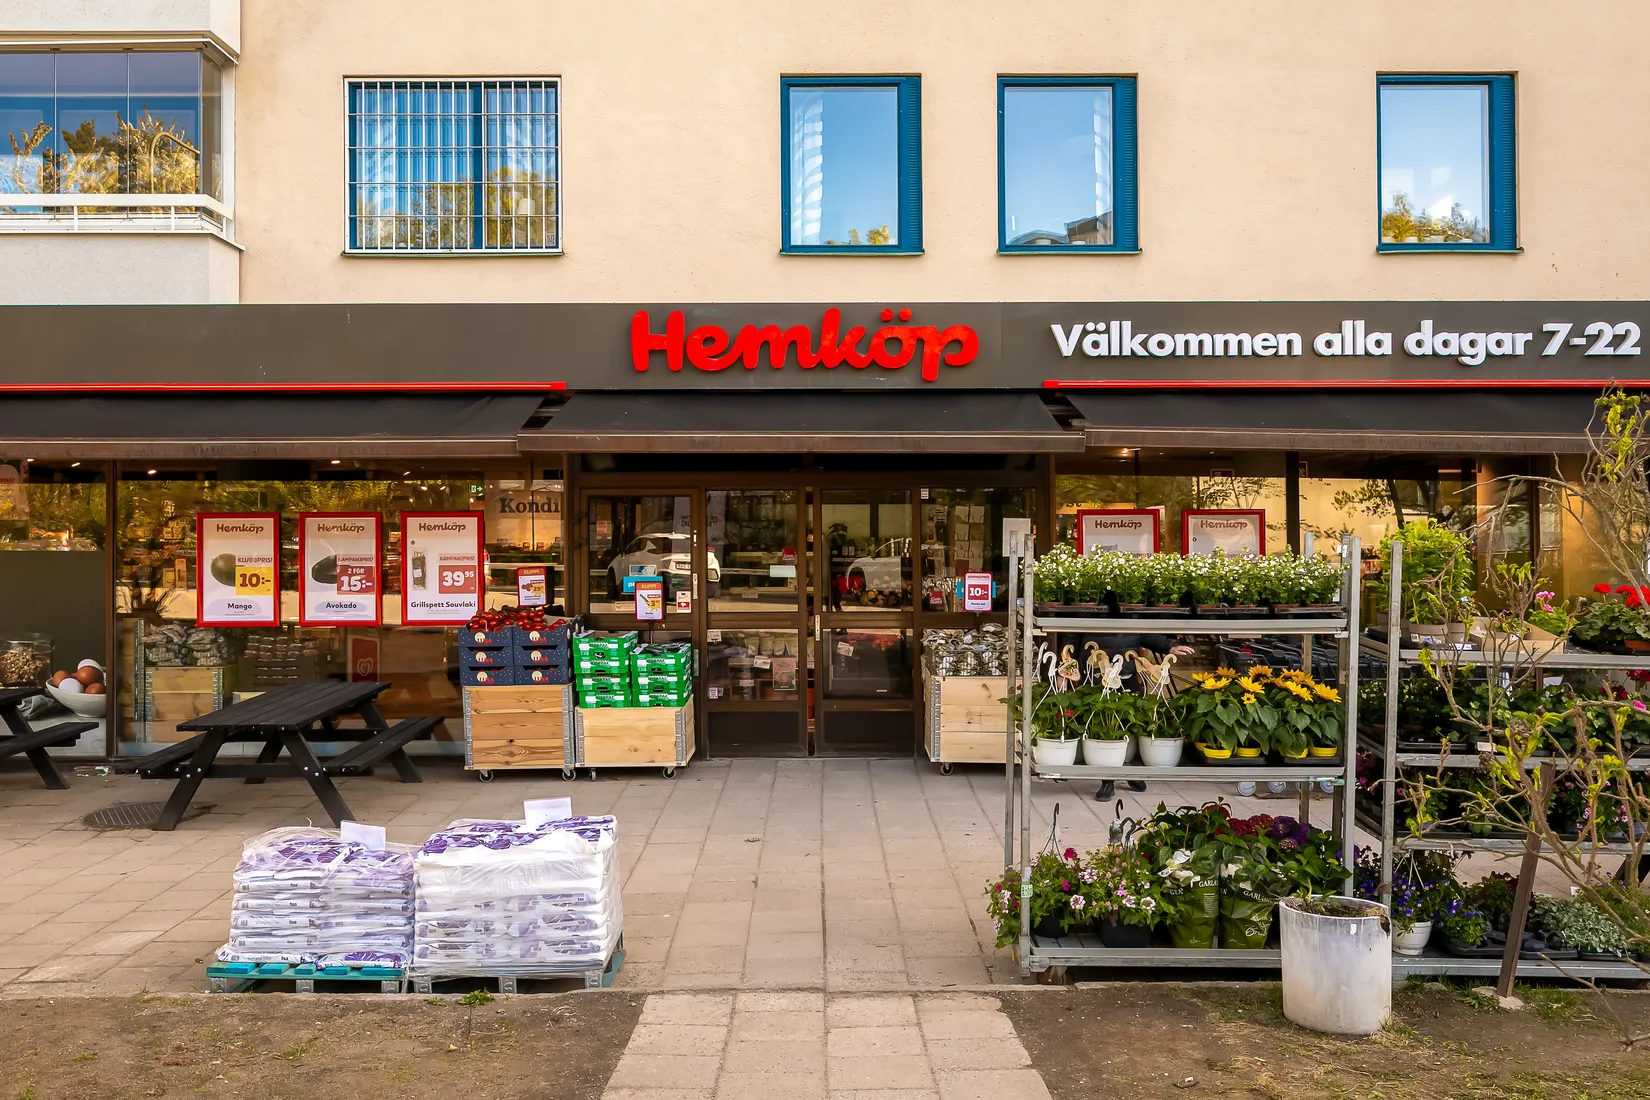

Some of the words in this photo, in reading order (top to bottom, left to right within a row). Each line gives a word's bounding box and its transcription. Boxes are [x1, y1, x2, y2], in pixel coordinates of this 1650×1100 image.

[631, 307, 979, 382] Hemköp
[1050, 320, 1302, 357] Välkommen
[1313, 319, 1392, 356] alla
[1403, 319, 1533, 366] dagar
[1541, 321, 1641, 356] 7-22
[499, 497, 560, 514] Kondi
[216, 523, 264, 534] Hemköp
[317, 523, 365, 533] Hemköp
[418, 522, 466, 532] Hemköp
[1095, 519, 1142, 529] Hemköp
[1200, 519, 1248, 529] Hemköp
[227, 603, 253, 611] Mango
[411, 601, 444, 609] Grillspett
